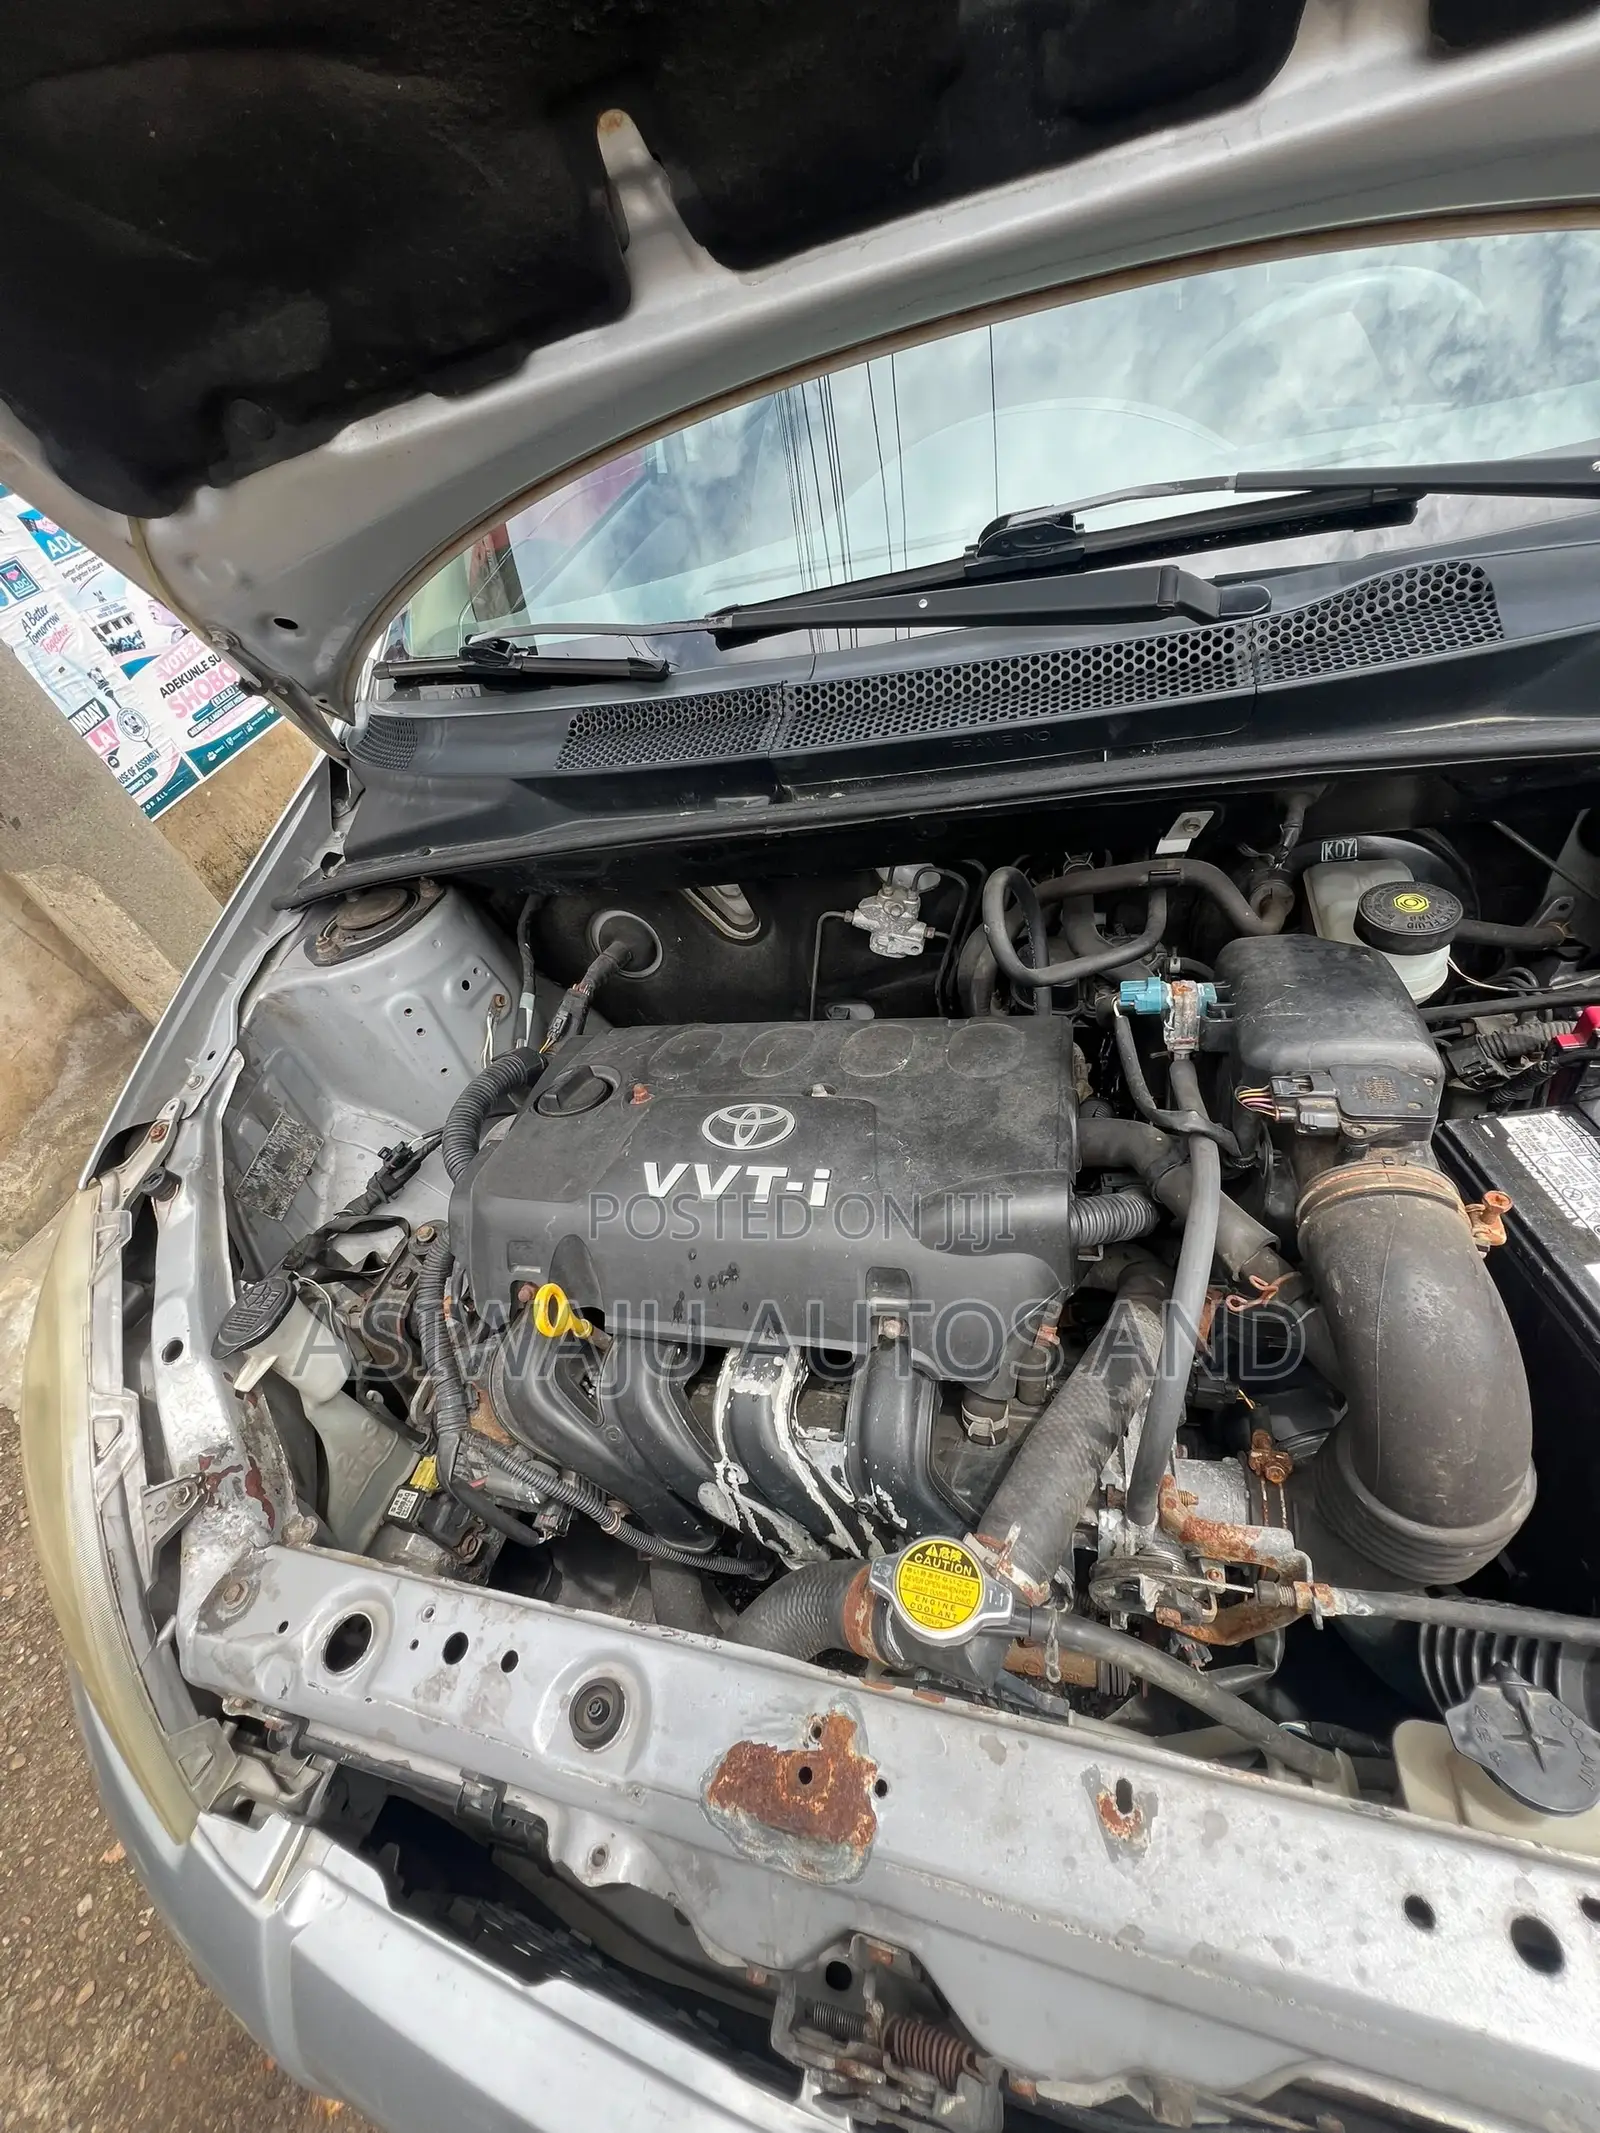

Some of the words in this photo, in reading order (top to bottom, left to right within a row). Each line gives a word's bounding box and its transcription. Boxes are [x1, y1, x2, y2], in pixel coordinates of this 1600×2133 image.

[14, 577, 31, 592] ADC
[21, 618, 31, 633] A
[28, 603, 50, 627] Better
[25, 611, 61, 646] Tomorrow
[160, 650, 190, 677] VOTE
[159, 659, 210, 699] ADEKUNLE
[136, 748, 162, 770] ASSEMBLY
[155, 790, 168, 803] ALL
[1323, 839, 1356, 861] K07
[643, 1161, 832, 1208] VVT-i
[914, 1552, 972, 1577] CAUTION
[909, 1601, 958, 1620] COOLANT
[915, 1594, 957, 1612] ENGINE
